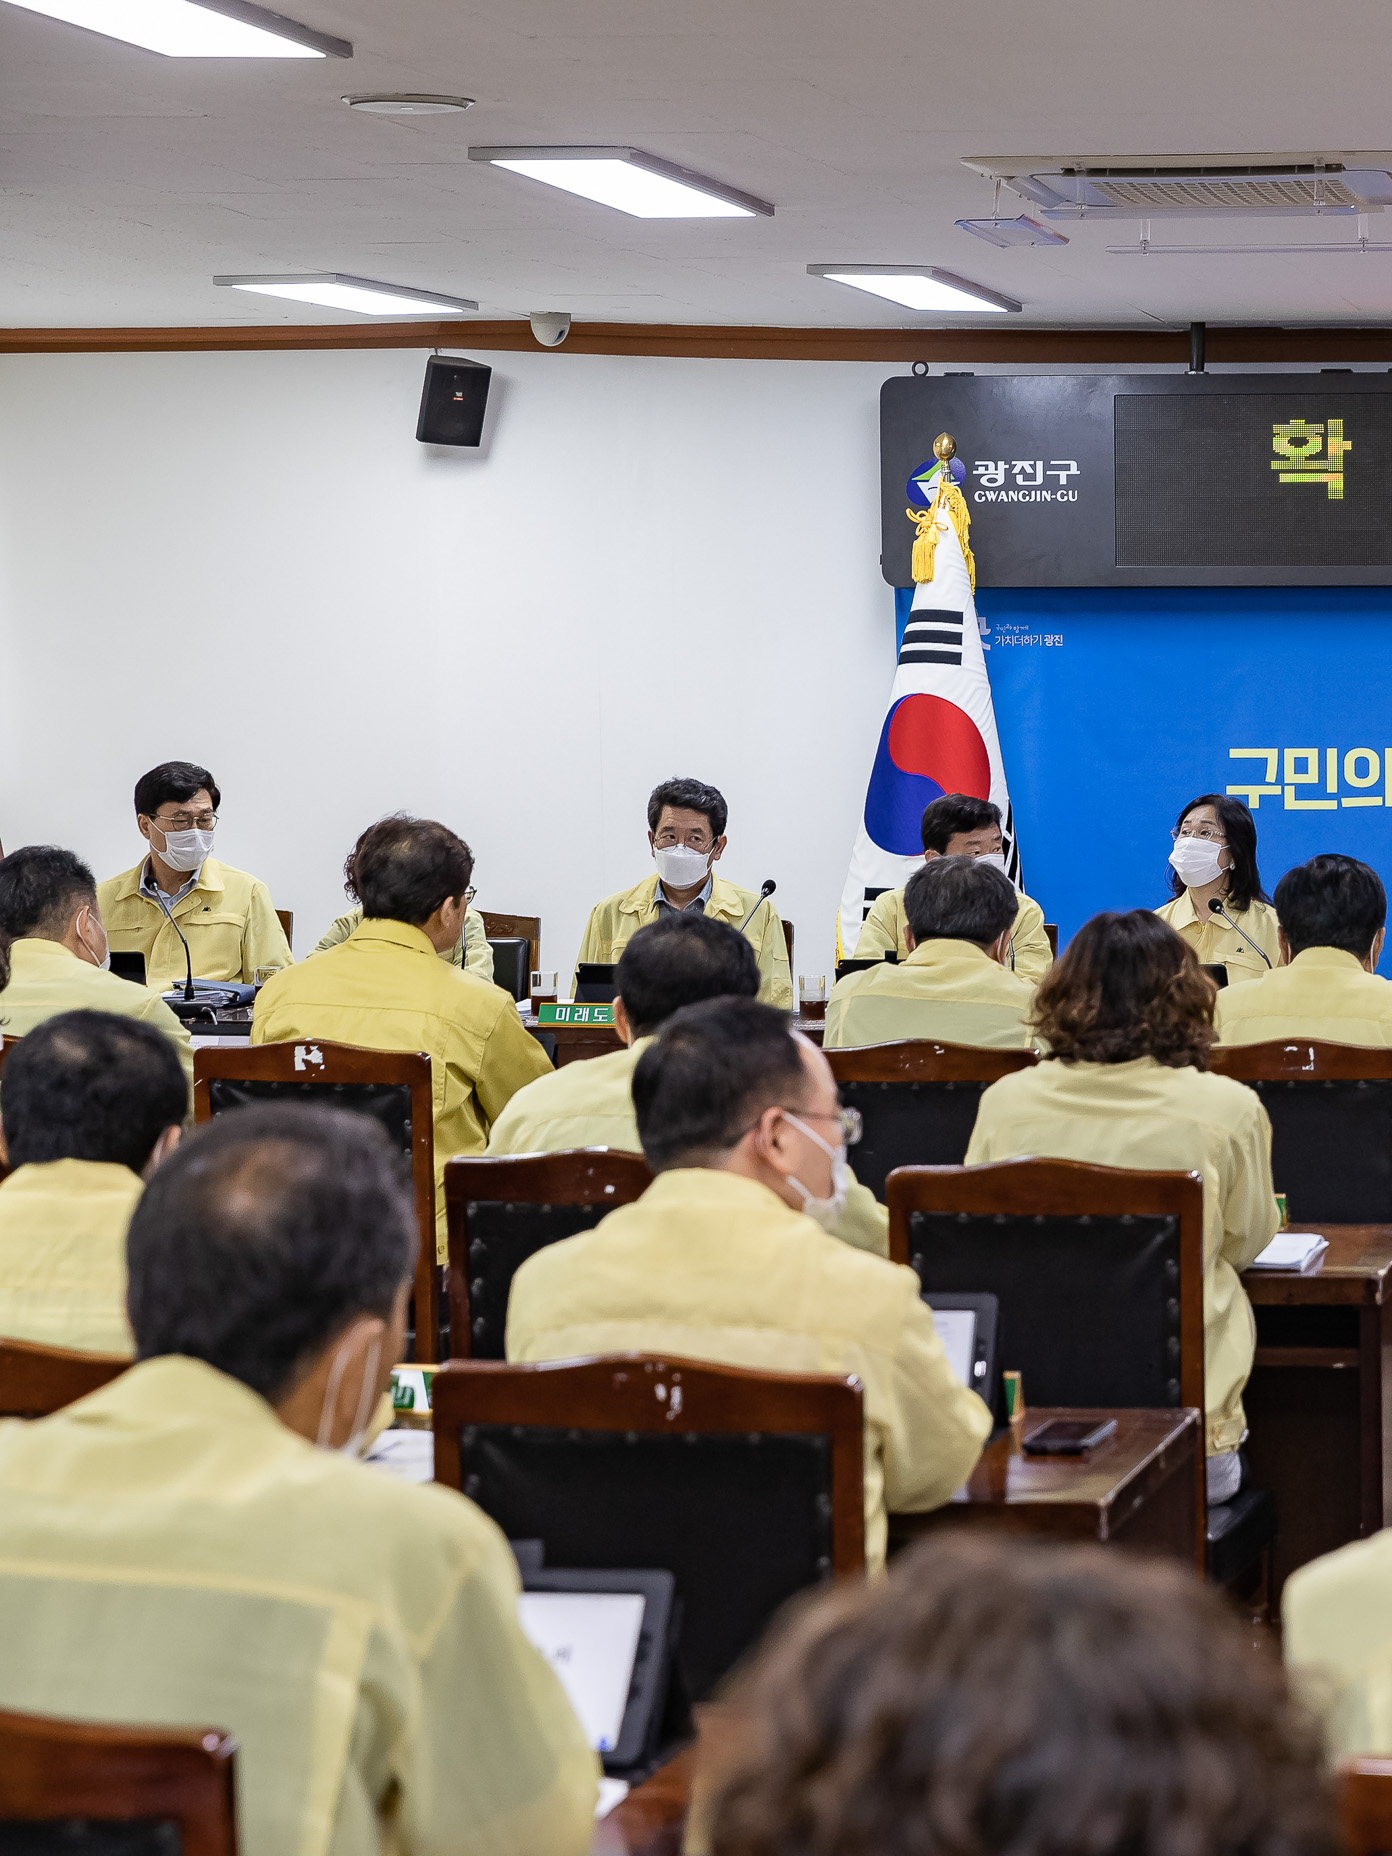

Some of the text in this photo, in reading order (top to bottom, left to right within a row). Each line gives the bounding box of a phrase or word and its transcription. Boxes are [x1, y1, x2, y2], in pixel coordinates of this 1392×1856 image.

[973, 460, 1080, 487] 광진구
[974, 489, 1078, 503] GWANGJIN-GU
[995, 634, 1064, 647] 가치더하기 광진
[555, 1007, 616, 1022] 미래도
